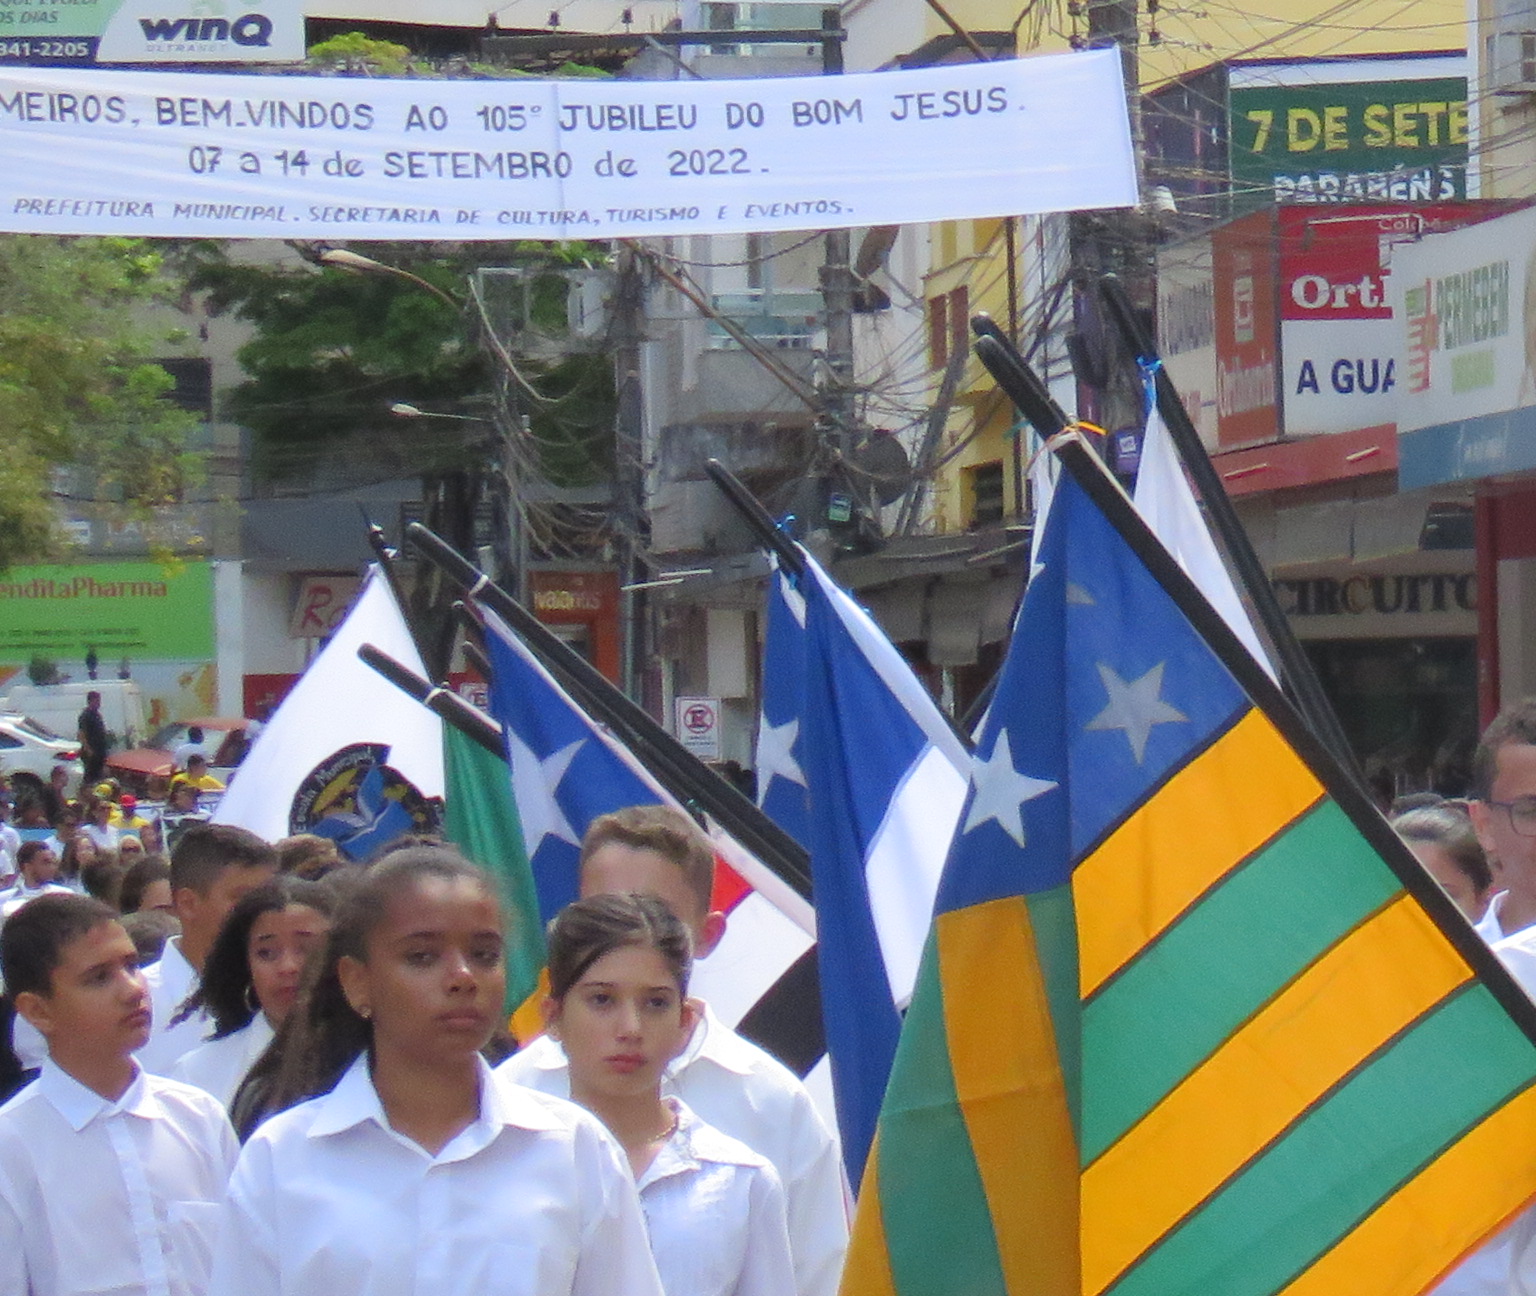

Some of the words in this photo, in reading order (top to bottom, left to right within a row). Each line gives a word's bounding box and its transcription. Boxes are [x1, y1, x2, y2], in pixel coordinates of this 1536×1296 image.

[405, 104, 448, 131] AO
[558, 103, 697, 132] JUBILEU
[726, 103, 764, 130] DO
[793, 99, 863, 127] BOM
[1247, 109, 1274, 152] 7
[1287, 106, 1350, 152] DE
[188, 146, 222, 174] 07
[239, 152, 261, 174] a
[274, 149, 311, 176] 14
[323, 151, 364, 178] de
[383, 152, 573, 179] SETEMBRO
[594, 151, 638, 178] de
[667, 148, 770, 177] 2022.
[13, 199, 154, 218] PREFEITURA
[309, 204, 440, 224] SECRETARIA
[456, 210, 481, 224] DE
[606, 206, 700, 223] TURISMO
[717, 204, 727, 221] E
[1296, 359, 1321, 395] A
